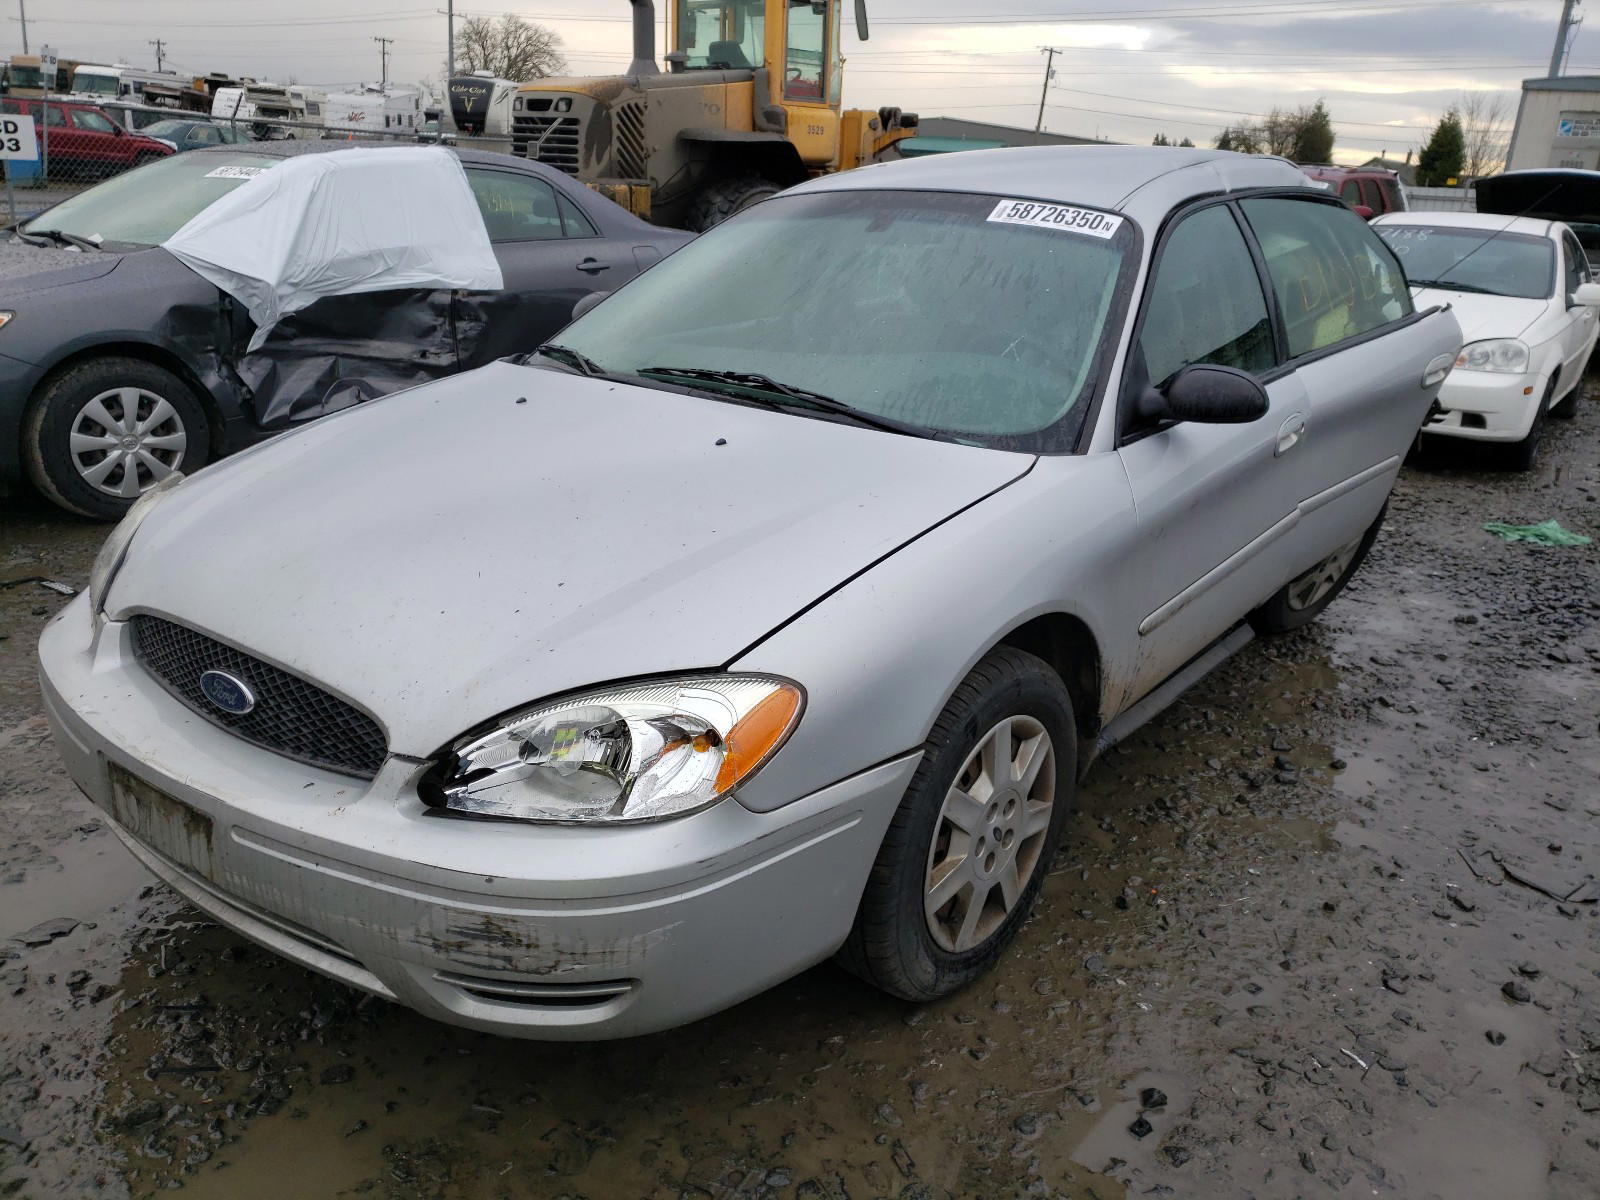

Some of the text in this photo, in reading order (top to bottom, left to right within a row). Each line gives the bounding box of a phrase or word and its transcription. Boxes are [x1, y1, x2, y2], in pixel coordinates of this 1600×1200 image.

[0, 120, 19, 134] D
[1006, 202, 1105, 230] 58726350
[210, 678, 240, 706] Ford
